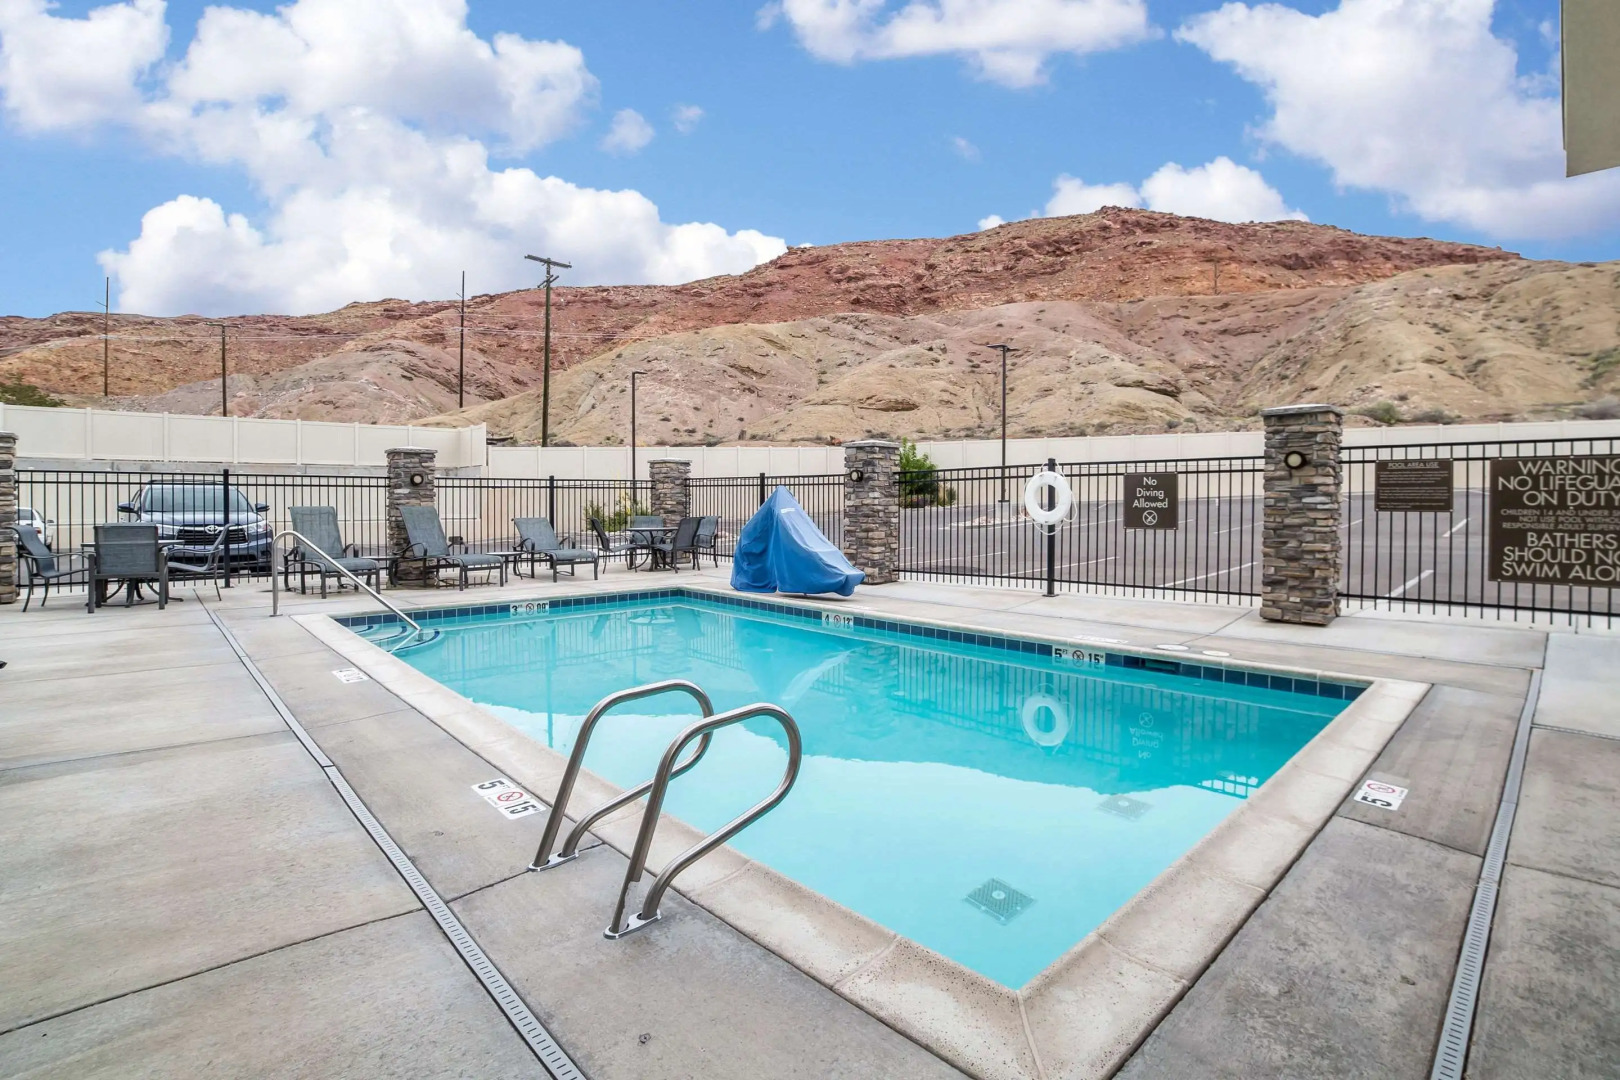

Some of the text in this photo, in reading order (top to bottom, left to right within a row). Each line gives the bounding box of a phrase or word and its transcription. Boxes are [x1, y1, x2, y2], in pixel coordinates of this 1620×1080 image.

[1143, 476, 1157, 486] No
[1498, 476, 1532, 491] NO
[1136, 487, 1164, 499] Diving
[1523, 491, 1558, 506] ON
[1132, 498, 1168, 508] Allowed
[1578, 509, 1609, 517] UNDER
[1502, 522, 1555, 530] RESPONSIBLE
[1557, 523, 1585, 531] ADULT
[1527, 532, 1618, 549] BATHERS
[1503, 546, 1587, 564] SHOULD
[1501, 562, 1620, 581] SWIM ALO
